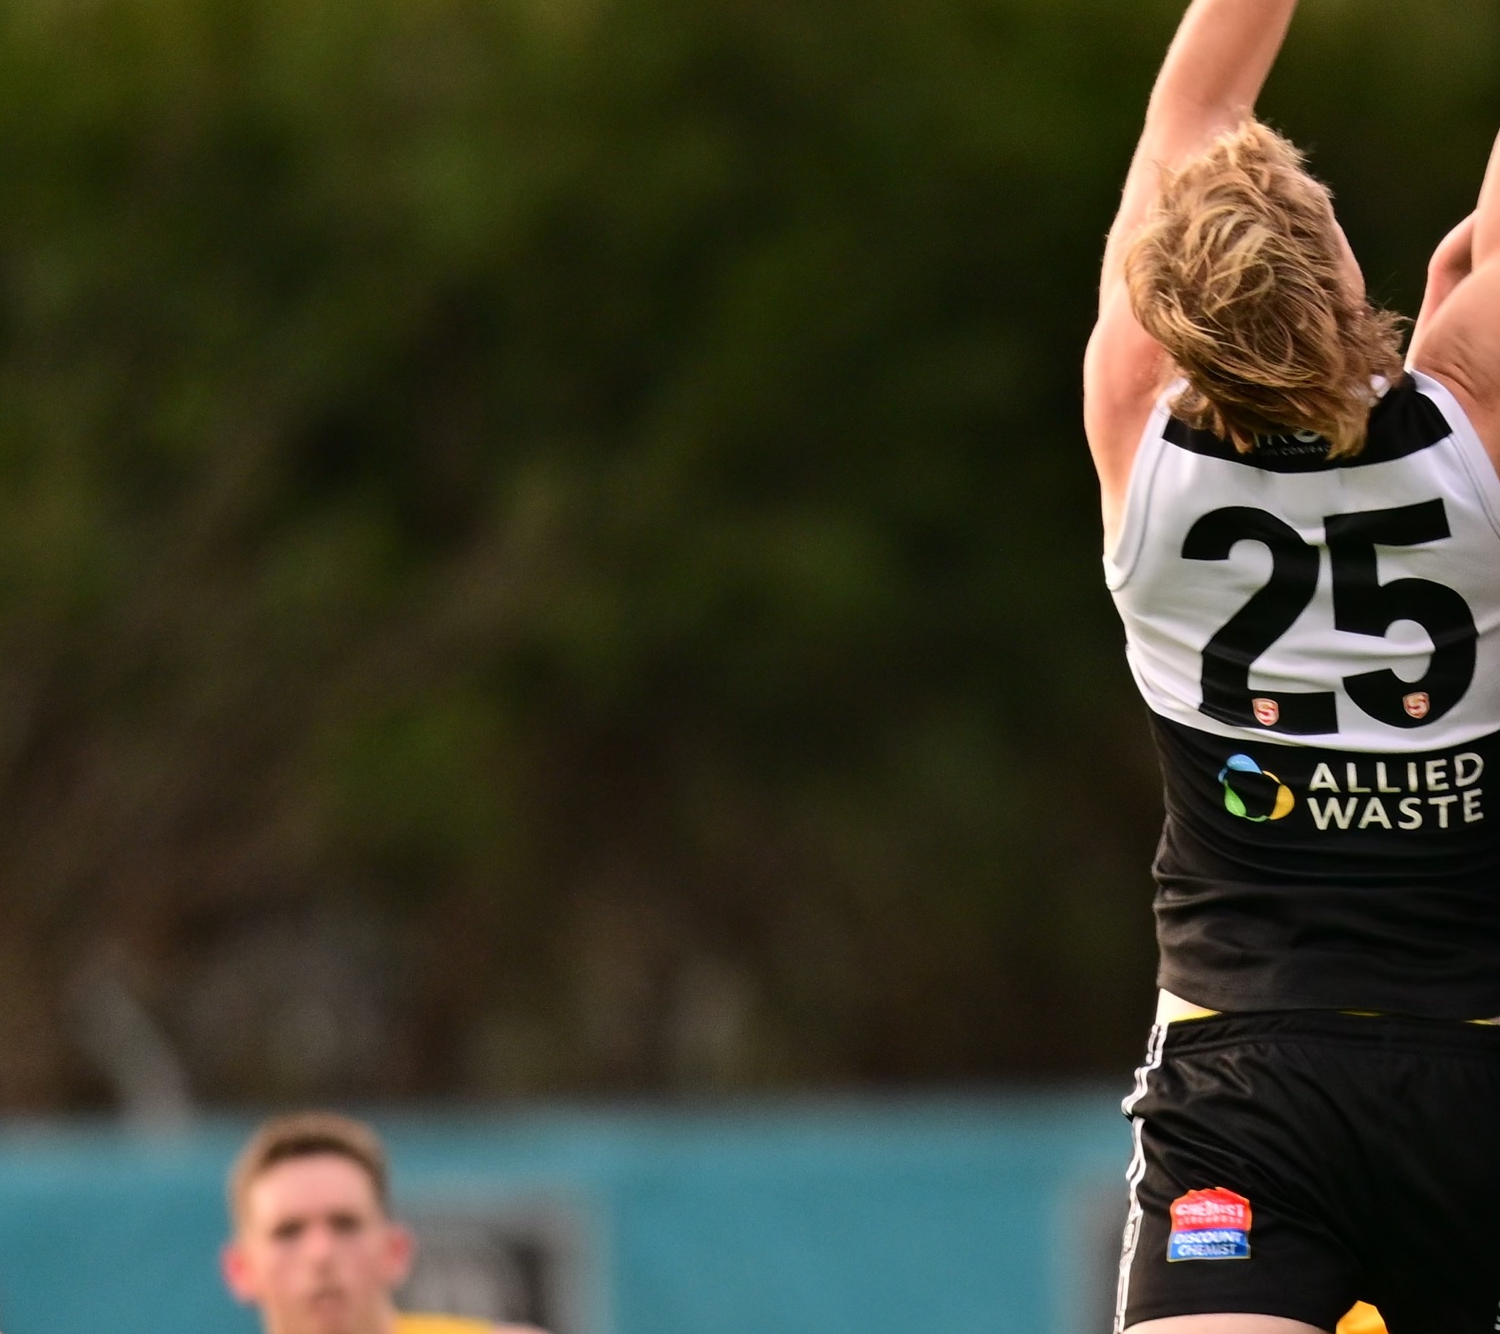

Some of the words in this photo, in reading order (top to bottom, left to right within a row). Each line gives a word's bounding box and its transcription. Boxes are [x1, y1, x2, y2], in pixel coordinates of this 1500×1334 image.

[1182, 497, 1479, 735] 25
[1308, 752, 1485, 795] ALLIED
[1307, 788, 1485, 831] WASTE
[1175, 1201, 1245, 1218] CHEMIST
[1173, 1231, 1243, 1244] DISCOUNT
[1177, 1243, 1238, 1257] CHEMIST
